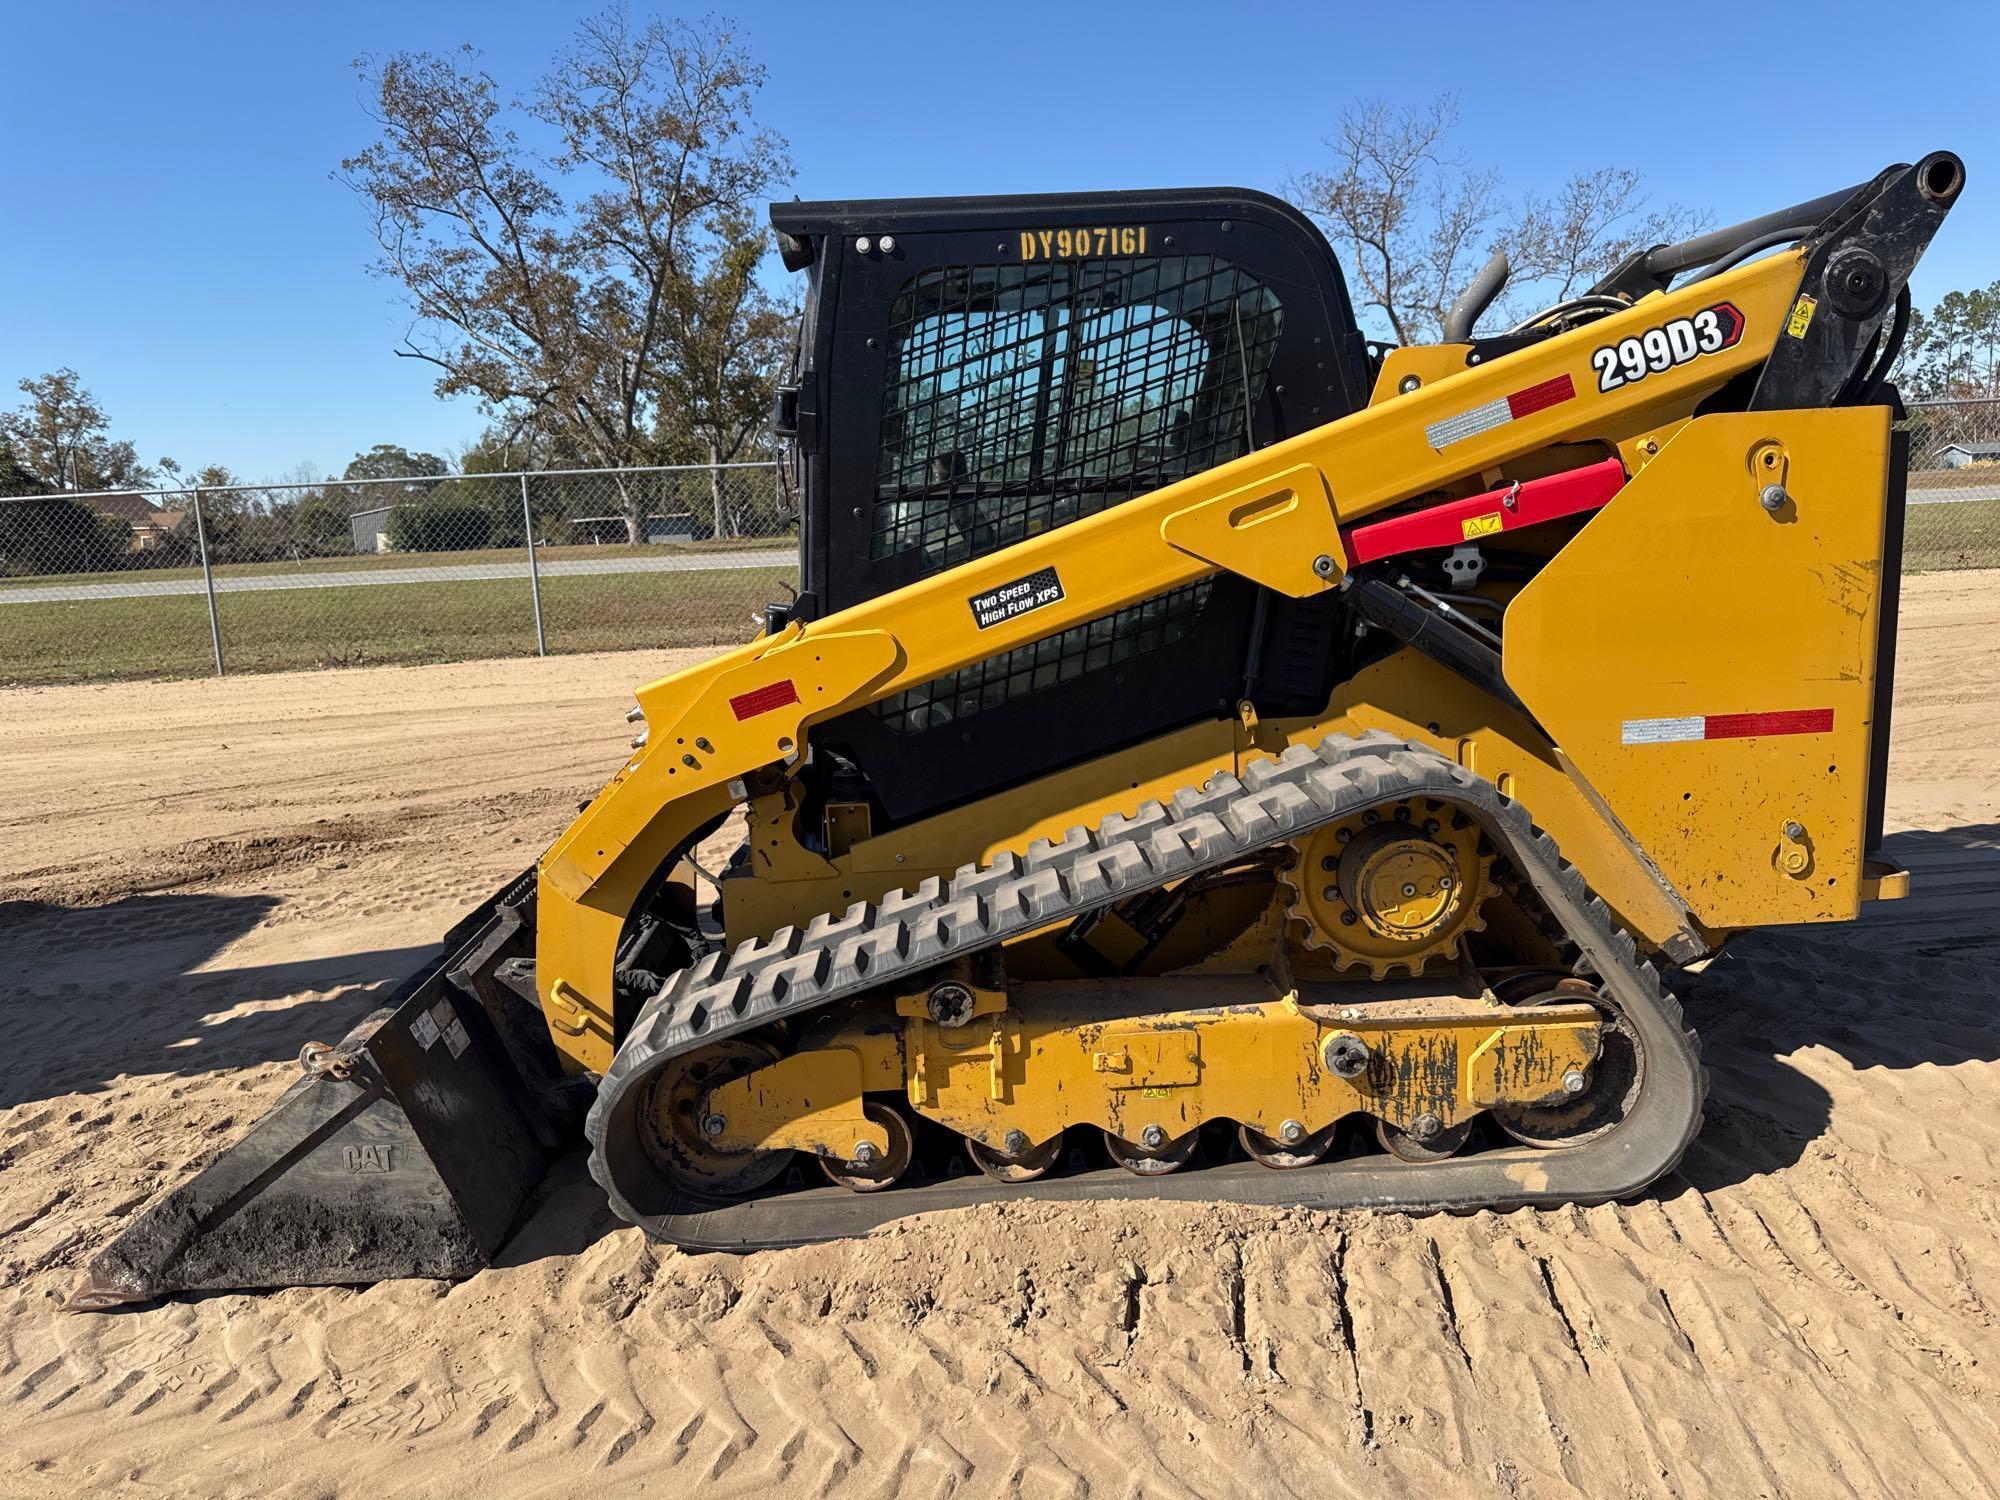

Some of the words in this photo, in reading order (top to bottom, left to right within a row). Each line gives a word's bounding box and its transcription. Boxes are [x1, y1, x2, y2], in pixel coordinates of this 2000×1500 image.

[1020, 227, 1146, 260] DY907161
[1593, 310, 1723, 391] 299D3
[974, 596, 998, 612] TWO
[998, 583, 1031, 603] SPEED
[980, 608, 1006, 626] HIGH
[1007, 597, 1034, 616] FLOW
[1036, 586, 1059, 604] XPS
[342, 1144, 392, 1175] CAT
